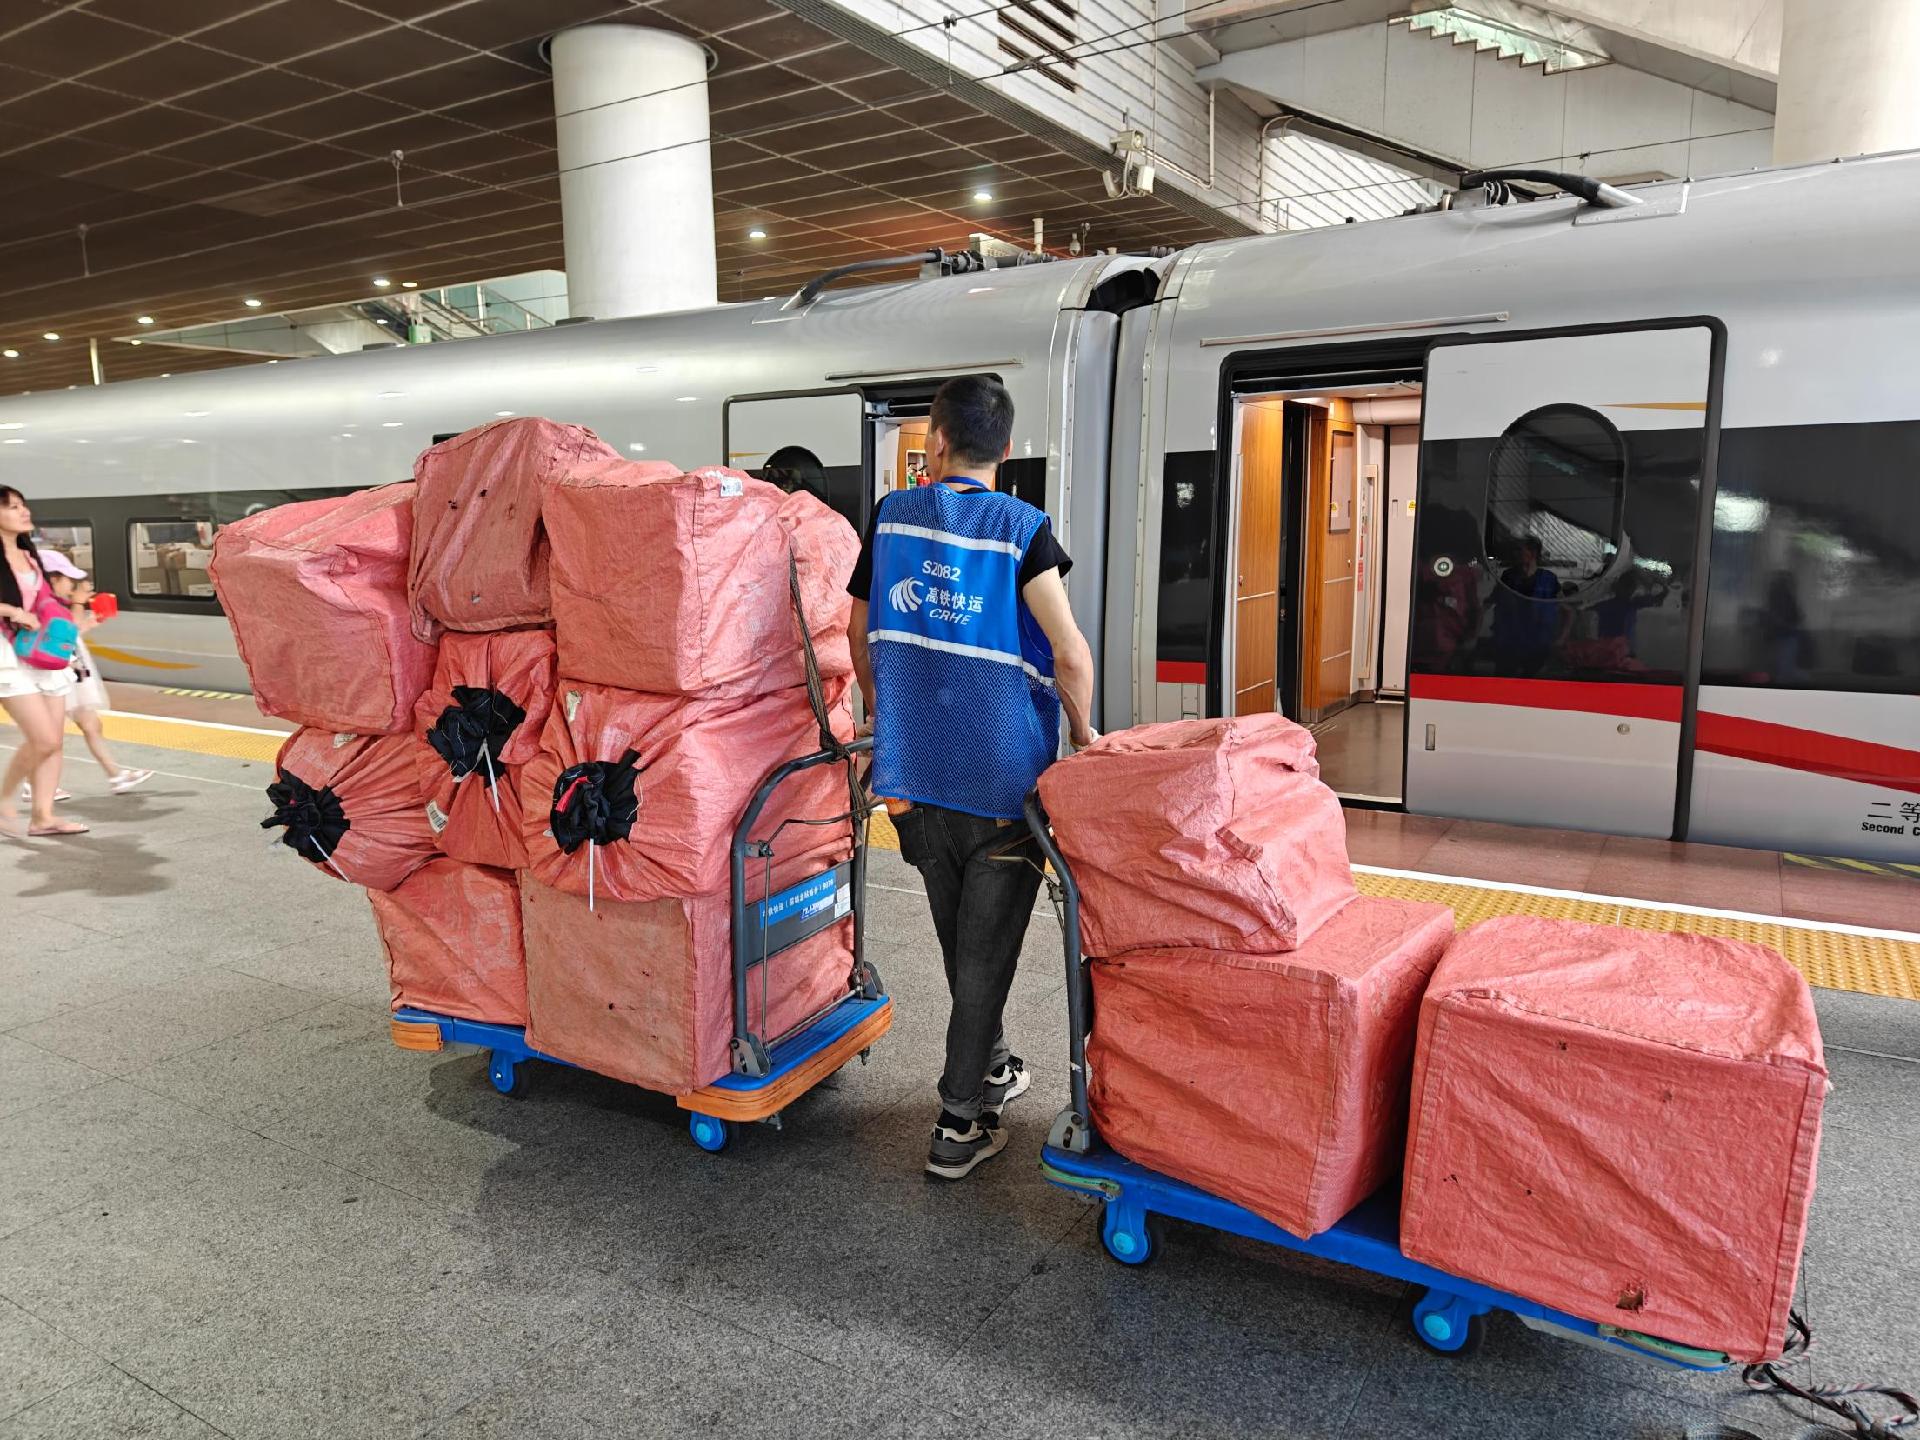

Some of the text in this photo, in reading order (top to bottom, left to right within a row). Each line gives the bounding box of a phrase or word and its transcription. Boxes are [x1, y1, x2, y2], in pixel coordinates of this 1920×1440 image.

[922, 560, 961, 582] S2082
[925, 587, 984, 613] 高铁快运
[1861, 822, 1905, 835] Second
